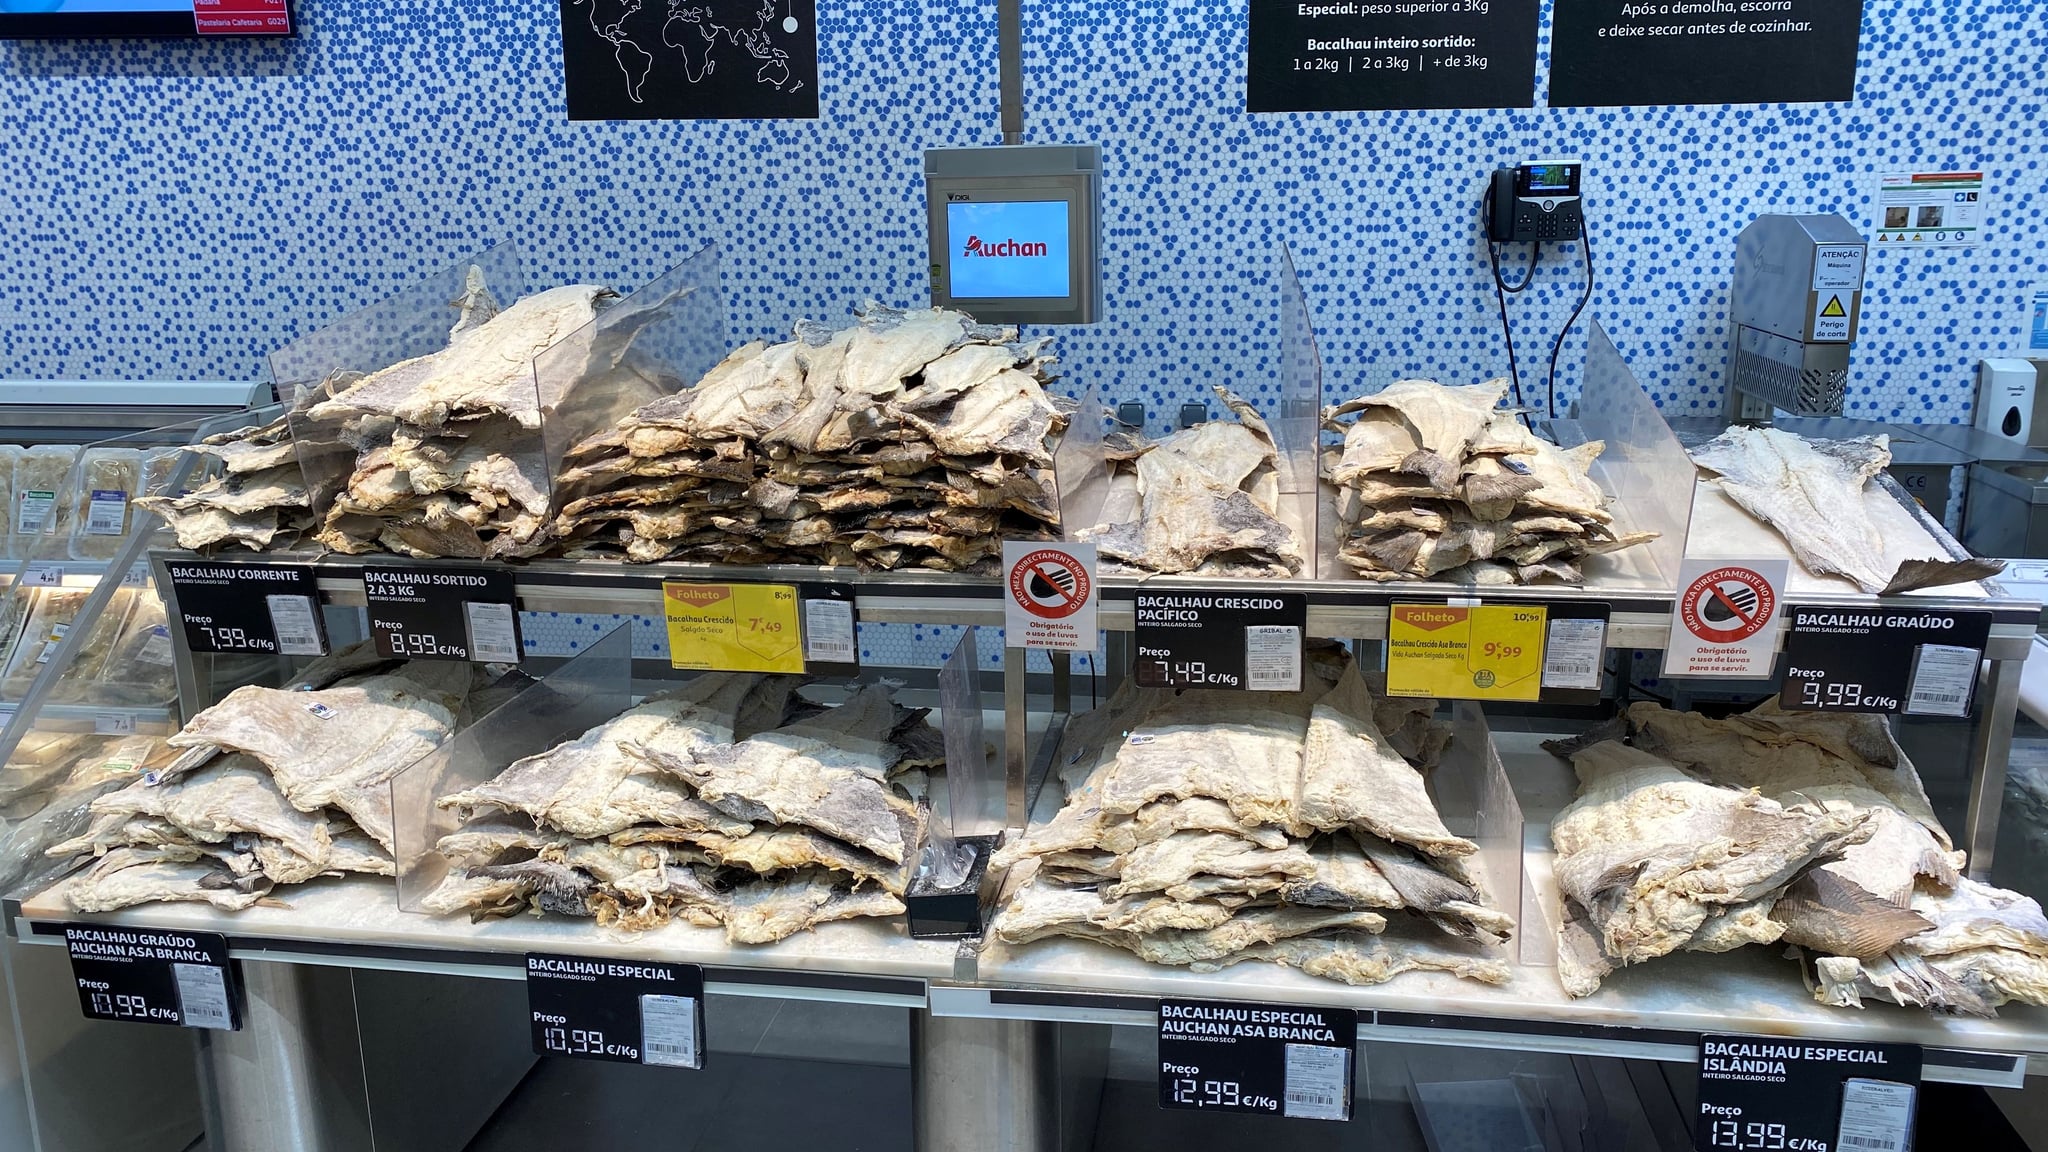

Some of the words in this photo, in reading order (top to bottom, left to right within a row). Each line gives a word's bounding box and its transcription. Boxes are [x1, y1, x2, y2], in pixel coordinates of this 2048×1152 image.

[1298, 2, 1358, 18] Especial:
[1362, 3, 1392, 17] peso
[1395, 1, 1448, 16] superior
[1452, 2, 1460, 12] a
[1464, 0, 1489, 14] 3Kg
[1622, 2, 1656, 18] Após
[1660, 4, 1668, 14] a
[1672, 0, 1736, 14] demolha,
[1740, 1, 1792, 12] escorra
[1598, 26, 1606, 37] e
[1609, 24, 1644, 37] deixe
[1648, 24, 1684, 36] secar
[1687, 22, 1726, 35] antes
[1729, 20, 1746, 34] de
[1750, 18, 1812, 34] cozinhar.
[1307, 37, 1371, 51] Bacalhau
[1374, 36, 1419, 49] inteiro
[1422, 35, 1476, 48] sortido:
[1293, 58, 1301, 70] 1
[1304, 60, 1312, 70] a
[1315, 57, 1338, 72] 2kg
[1362, 57, 1371, 69] 2
[1374, 60, 1382, 69] a
[1385, 56, 1409, 71] 3kg
[1444, 55, 1460, 67] de
[1464, 54, 1488, 70] 3kg
[964, 235, 1047, 257] Auchan
[1820, 321, 1844, 329] Perigo
[1018, 552, 1076, 571] DIRECTAMENTE
[172, 567, 236, 579] BACALHAU
[237, 569, 300, 581] CORRENTE
[364, 572, 430, 584] BACALHAU
[433, 574, 487, 586] SORTIDO
[1073, 566, 1084, 577] NO
[1013, 570, 1022, 590] MEXA
[1694, 570, 1761, 590] DIRECTAMENTE
[367, 585, 376, 594] 2
[378, 585, 388, 595] A
[389, 586, 396, 595] 3
[398, 586, 414, 596] KG
[676, 590, 720, 600] Folheto
[1070, 578, 1087, 610] PRODUTO
[1758, 585, 1770, 596] NO
[1016, 592, 1030, 607] NÃO
[1138, 596, 1212, 608] BACALHAU
[1214, 598, 1284, 610] CRESCIDO
[1684, 591, 1696, 614] MEXA
[184, 614, 212, 626] Preço
[704, 616, 734, 624] Crescido
[1138, 608, 1199, 620] PACÍFICO
[1406, 611, 1456, 622] Folheto
[1746, 597, 1770, 632] PRODUTO
[1796, 614, 1882, 627] BACALHAU
[1886, 614, 1954, 629] GRAÚDO
[374, 620, 402, 632] Preço
[1030, 622, 1074, 630] Obrigatório
[1686, 615, 1700, 632] NÃO
[200, 627, 246, 650] 7,99
[248, 638, 274, 650] €/Kg
[1046, 630, 1056, 638] de
[1058, 630, 1078, 638] luvas
[390, 633, 437, 656] 8,99
[439, 646, 466, 658] €/Kg
[1391, 639, 1415, 648] Bacalhau
[1139, 646, 1170, 659] Preço
[1696, 648, 1747, 656] Obrigatório
[1154, 660, 1206, 685] 7,49
[1208, 673, 1238, 686] €/Kg
[1788, 667, 1825, 680] Preço
[1802, 682, 1862, 708] 9,99
[1863, 696, 1898, 710] €/Kg
[66, 929, 137, 944] BACALHAU
[140, 934, 196, 948] GRAÚDO
[70, 942, 126, 956] AUCHAN
[128, 946, 155, 958] ASA
[156, 948, 212, 962] BRANCA
[528, 958, 604, 975] BACALHAU
[608, 964, 675, 981] ESPECIAL
[78, 978, 110, 992] Preço
[150, 1008, 178, 1021] €/Kg
[533, 1012, 566, 1026] Preço
[1162, 1005, 1248, 1022] BACALHAU
[1251, 1010, 1326, 1026] ESPECIAL
[1162, 1020, 1230, 1036] AUCHAN
[1232, 1024, 1266, 1038] ASA
[1268, 1026, 1335, 1042] BRANCA
[544, 1028, 604, 1054] 10,99
[606, 1045, 638, 1058] €/Kg
[1188, 1035, 1218, 1043] SALGADO
[1220, 1036, 1236, 1044] SECO
[1704, 1042, 1800, 1059] BACALHAU
[1804, 1047, 1888, 1064] ESPECIAL
[1163, 1062, 1200, 1077] Preço
[1704, 1056, 1786, 1074] ISLÂNDIA
[1702, 1072, 1731, 1080] INTEIRO
[1731, 1074, 1766, 1082] SALGADO
[1174, 1079, 1239, 1107] 12,99
[1242, 1096, 1278, 1110] €/Kg
[1701, 1102, 1742, 1118] Preço
[1712, 1120, 1786, 1151] 13,99
[1788, 1138, 1827, 1152] €/Kg
